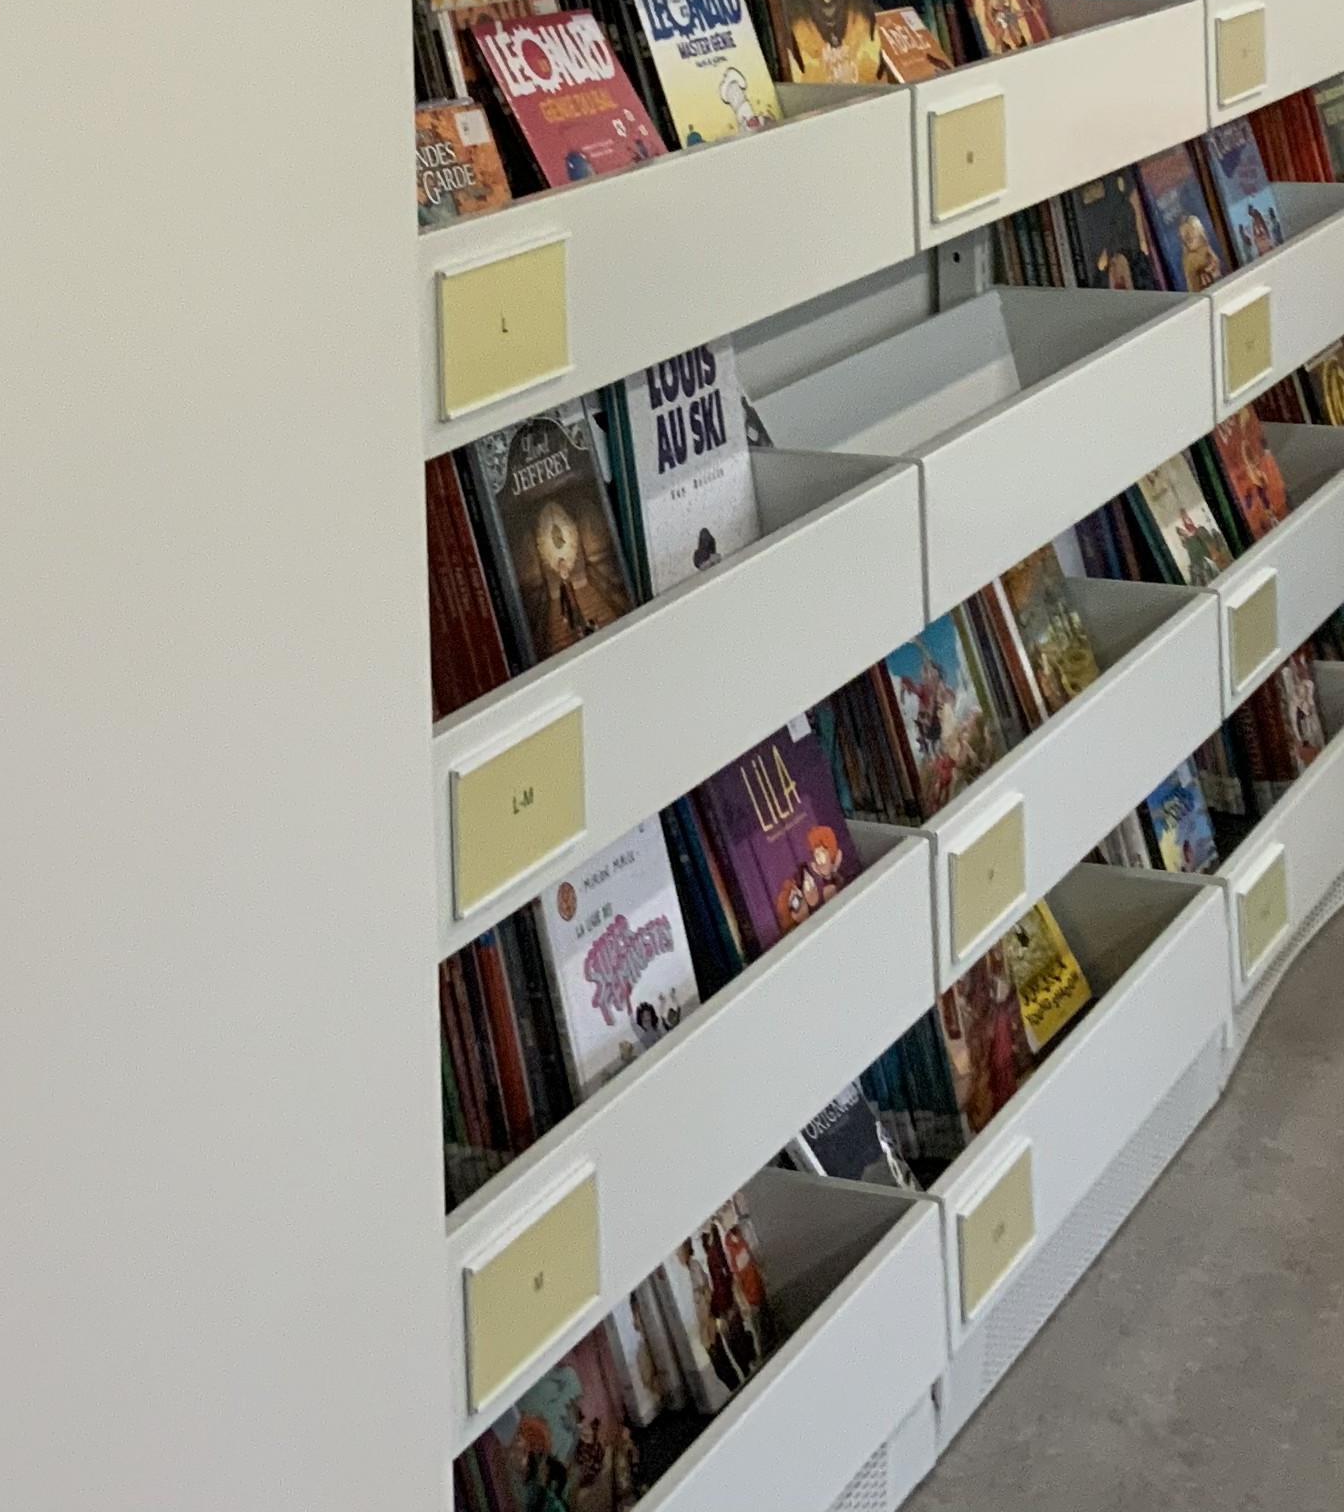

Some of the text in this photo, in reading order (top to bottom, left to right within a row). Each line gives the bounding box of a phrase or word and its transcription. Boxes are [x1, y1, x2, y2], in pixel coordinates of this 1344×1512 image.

[423, 164, 477, 205] GARDE
[501, 317, 509, 333] L
[645, 344, 717, 410] LOUIS
[656, 388, 727, 475] AU SKI
[511, 449, 572, 496] JEFFREY
[741, 744, 802, 833] LILA
